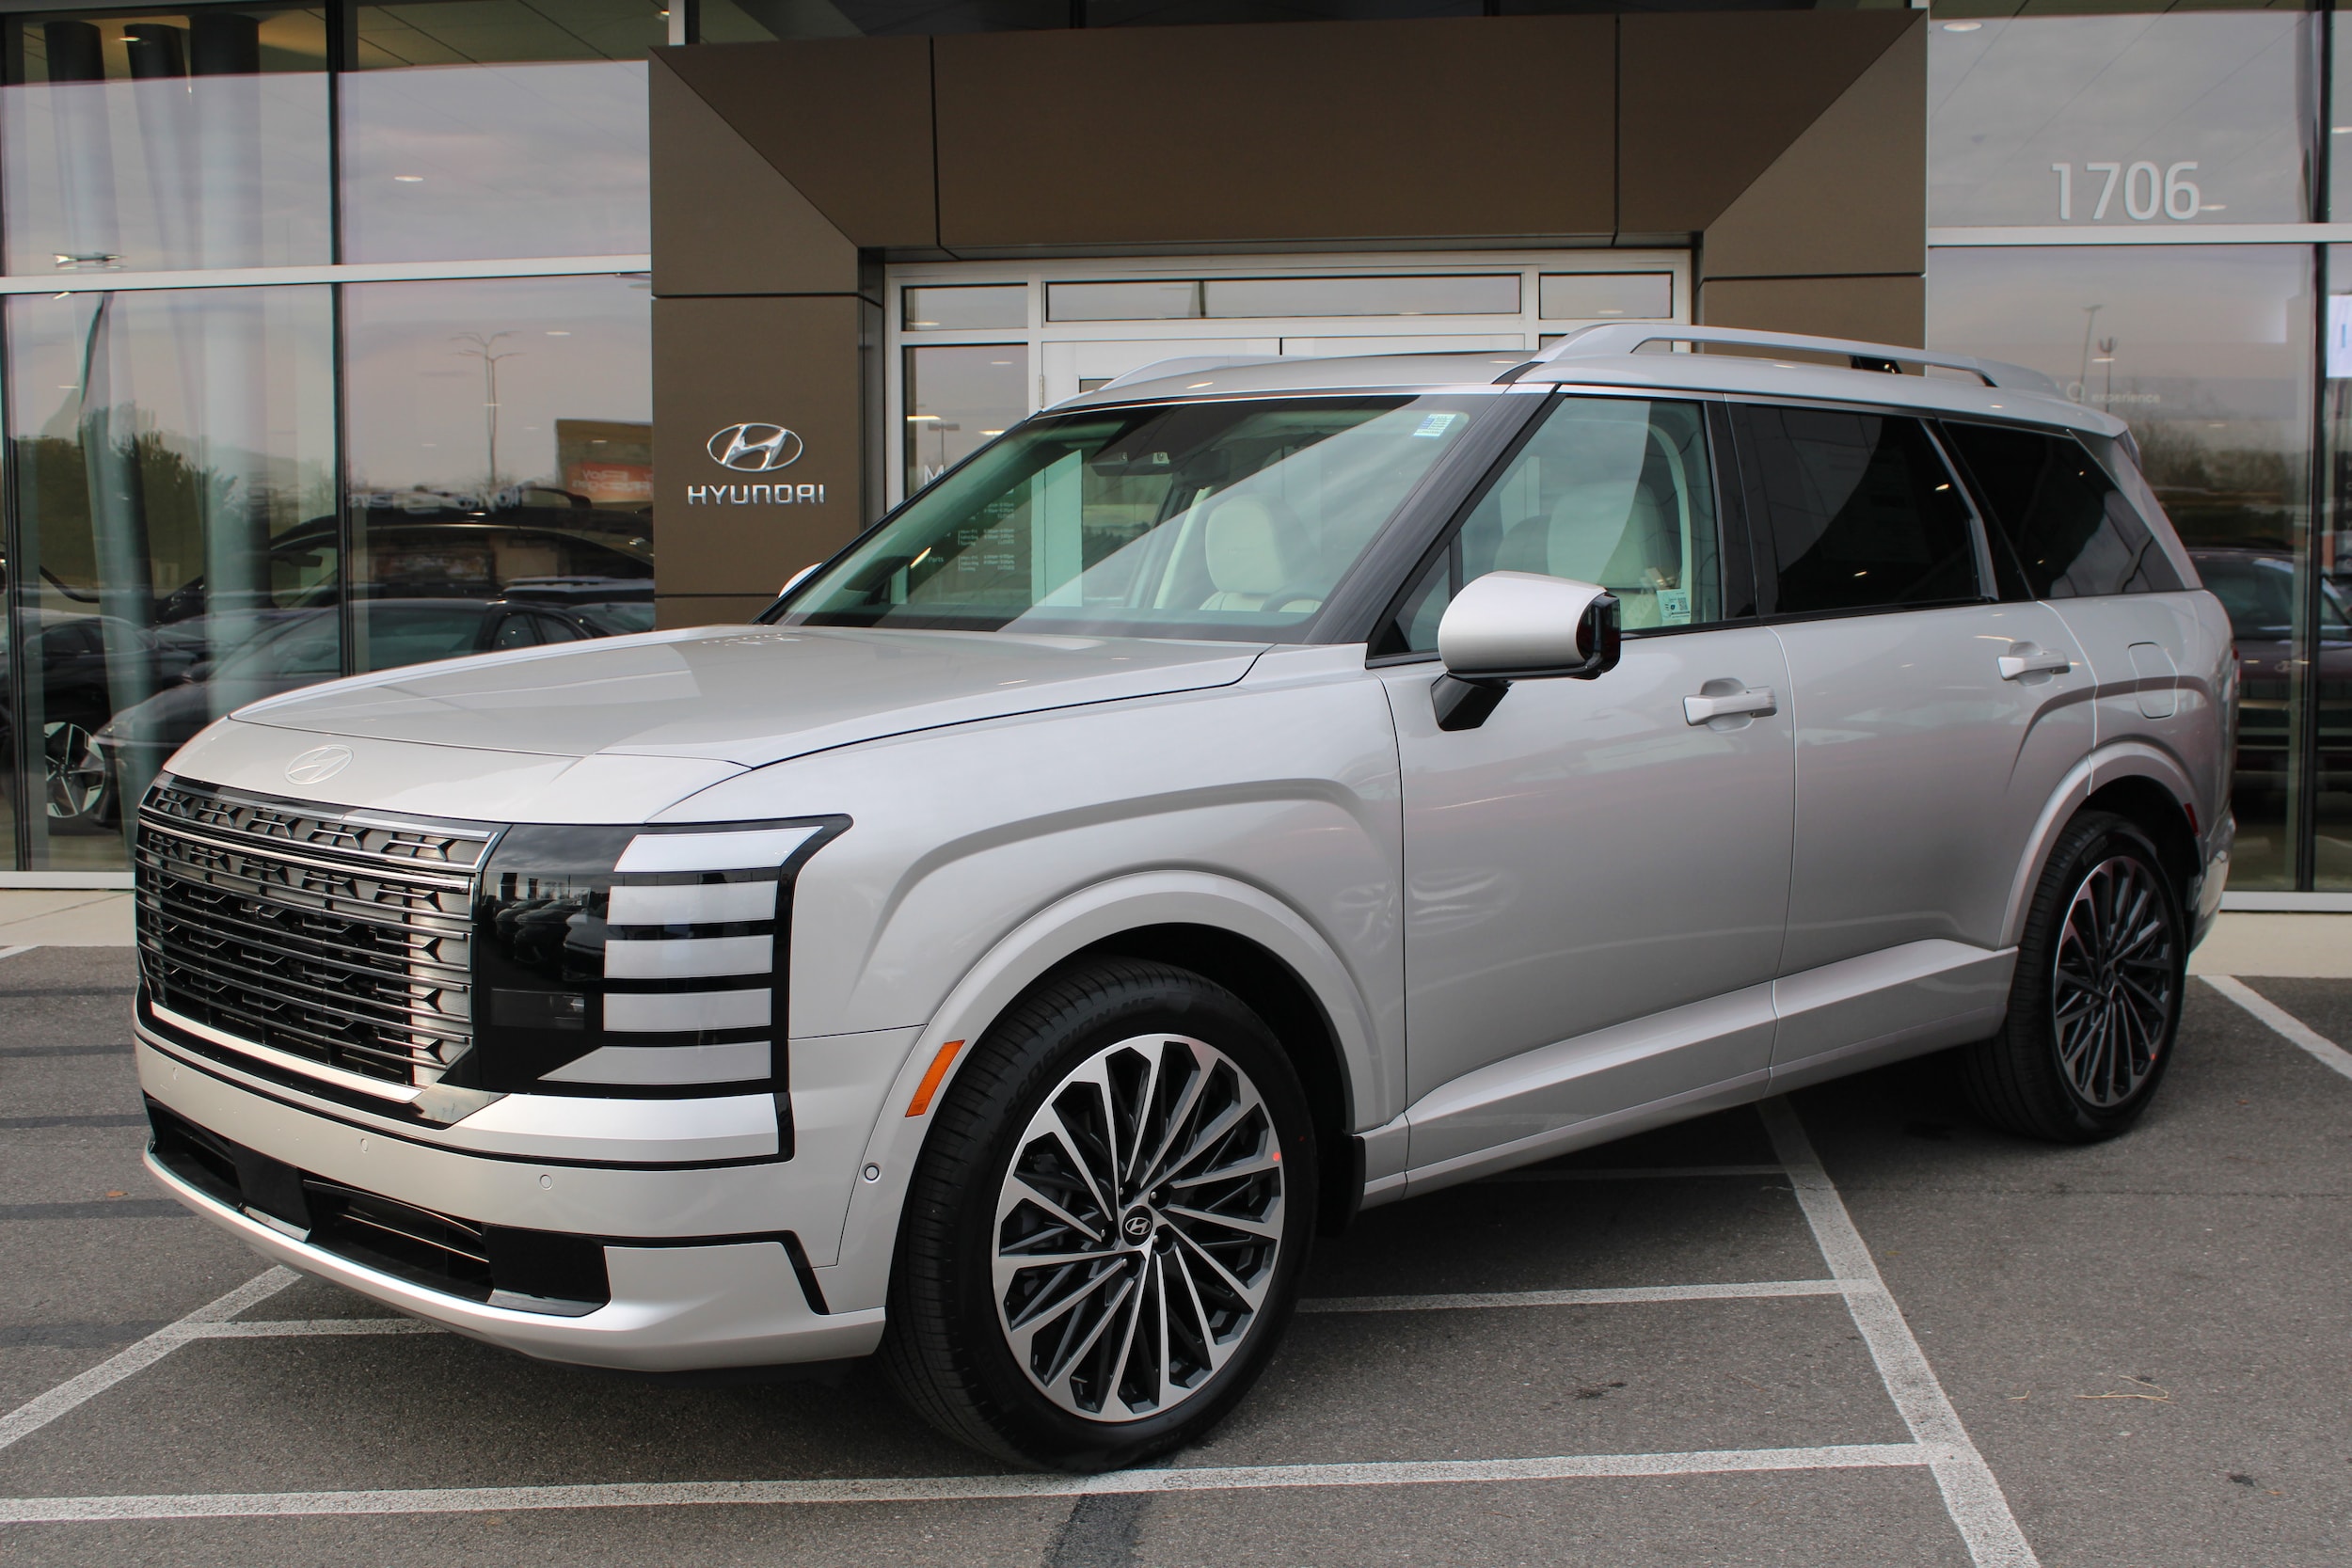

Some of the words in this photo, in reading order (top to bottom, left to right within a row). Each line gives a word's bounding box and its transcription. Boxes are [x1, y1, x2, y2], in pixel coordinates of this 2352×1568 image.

[2051, 161, 2201, 221] 1706
[2091, 391, 2160, 404] experience
[687, 483, 825, 505] HYUNDAI
